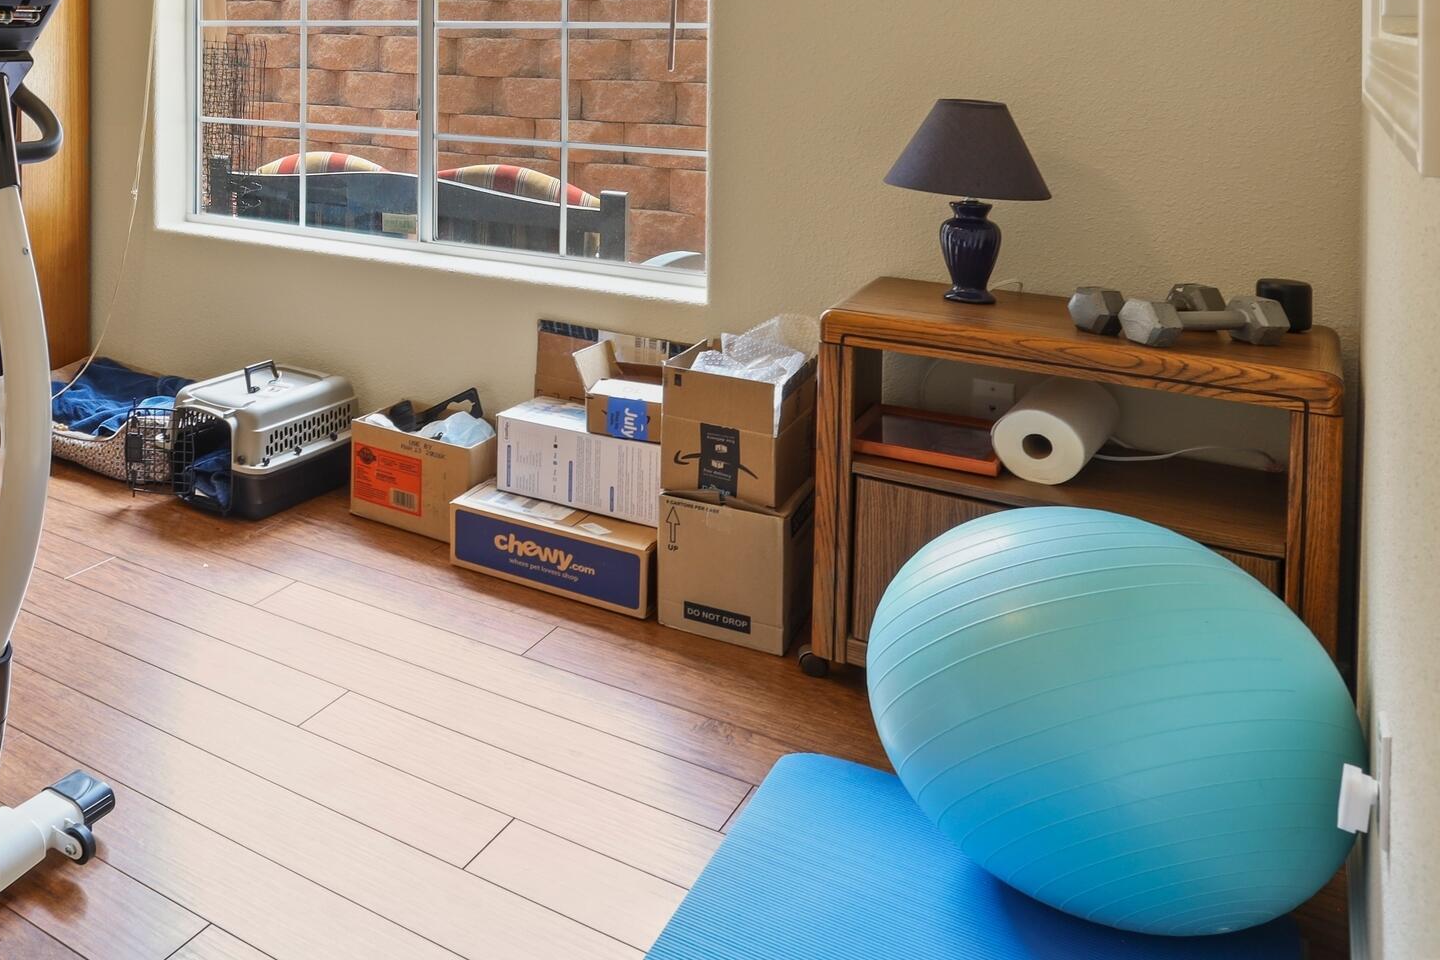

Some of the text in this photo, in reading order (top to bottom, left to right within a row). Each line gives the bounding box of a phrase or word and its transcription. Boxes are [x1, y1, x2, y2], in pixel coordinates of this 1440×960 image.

[621, 407, 638, 438] July
[493, 533, 596, 576] chewy.com
[667, 543, 679, 552] UP
[529, 563, 541, 573] pet
[562, 570, 579, 582] shop
[687, 607, 748, 628] DO NOT DROP
